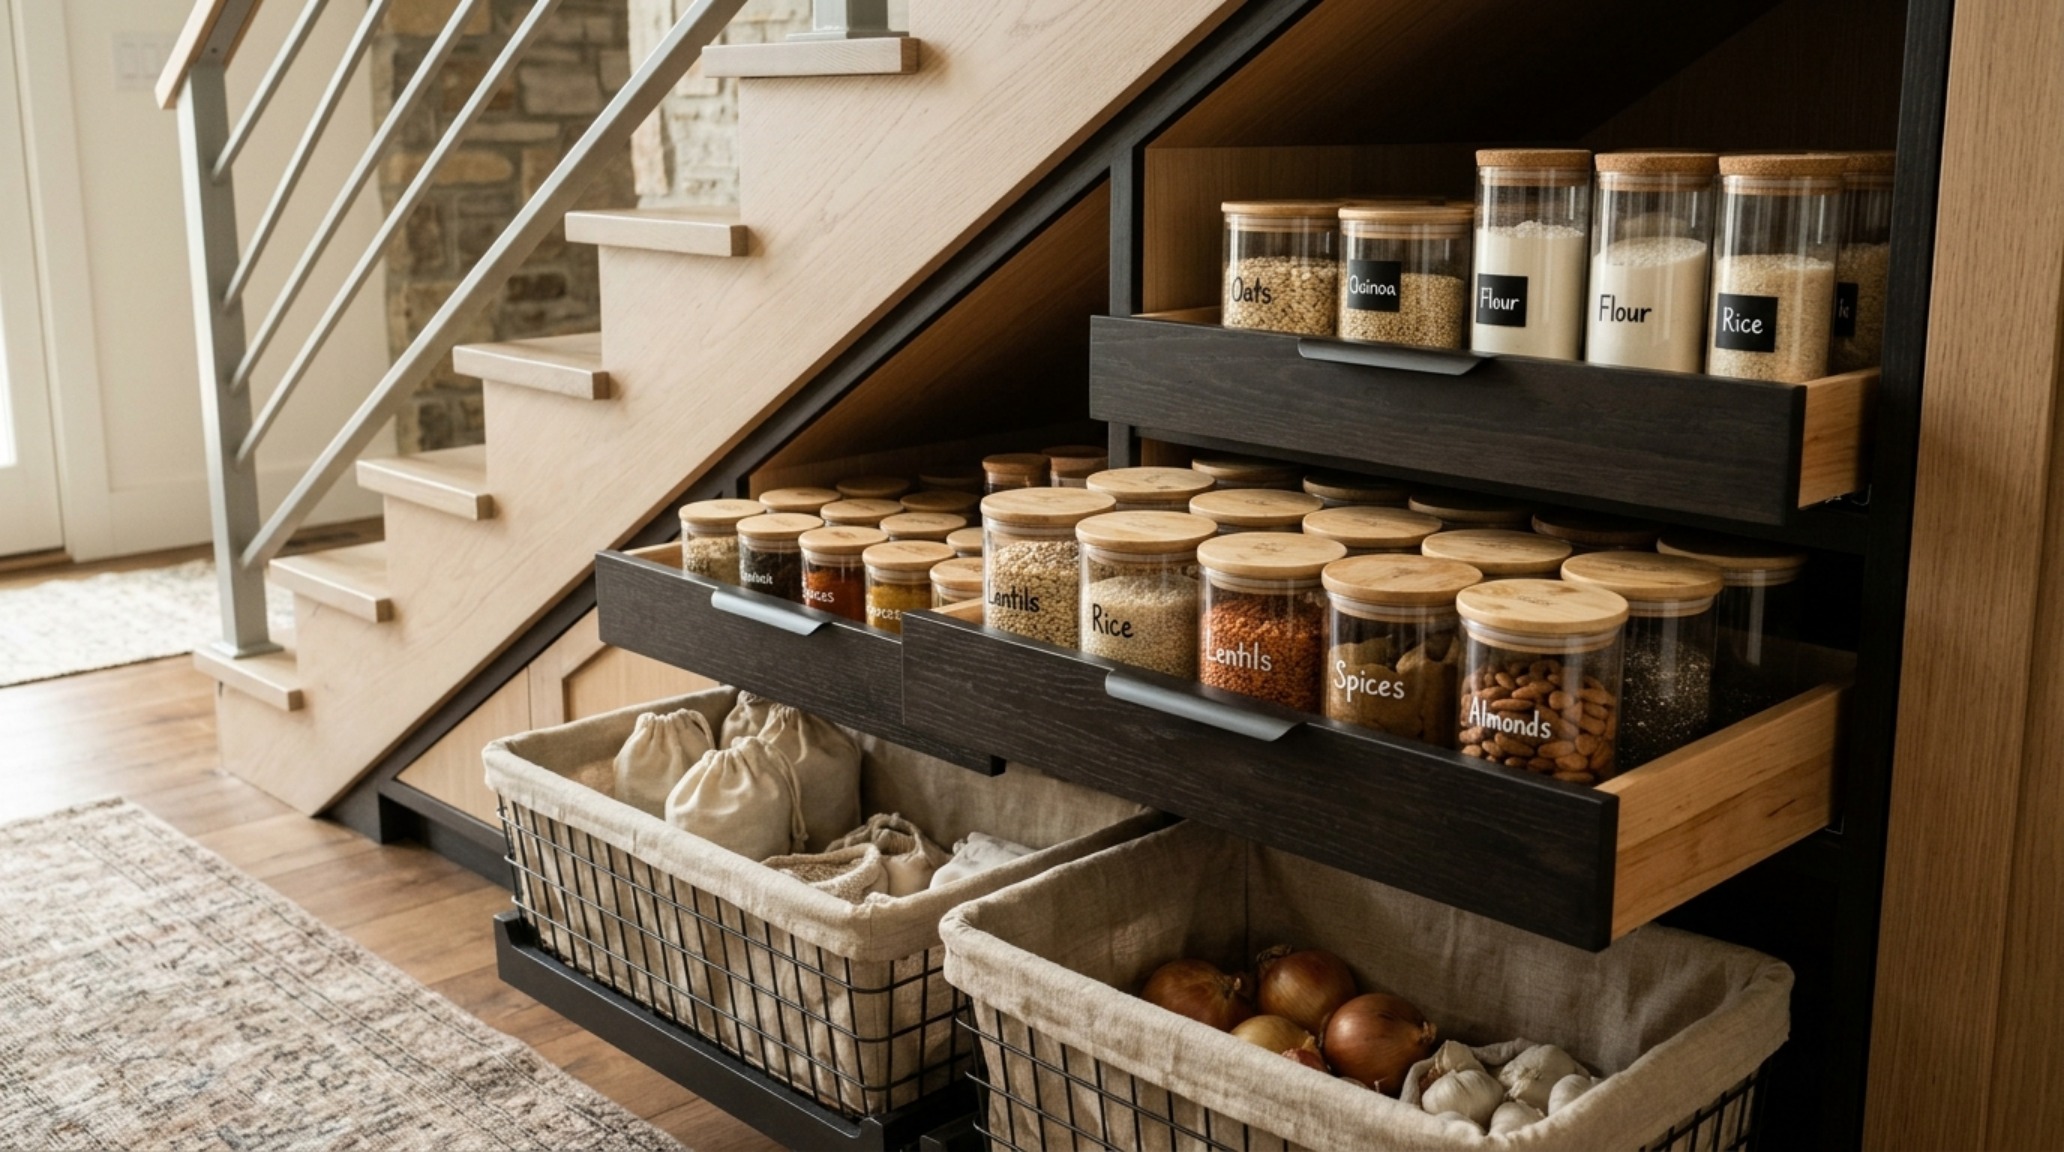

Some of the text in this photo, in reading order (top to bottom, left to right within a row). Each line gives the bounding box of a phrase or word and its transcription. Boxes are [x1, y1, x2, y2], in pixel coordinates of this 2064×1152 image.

[1231, 275, 1272, 305] Oats
[1479, 286, 1520, 312] Flour
[1598, 293, 1653, 323] Flour
[1721, 306, 1764, 335] Rice
[987, 582, 1040, 613] Lentils
[1091, 602, 1135, 639] Rice
[1333, 659, 1406, 703] Spices
[1468, 695, 1553, 740] Almonds
